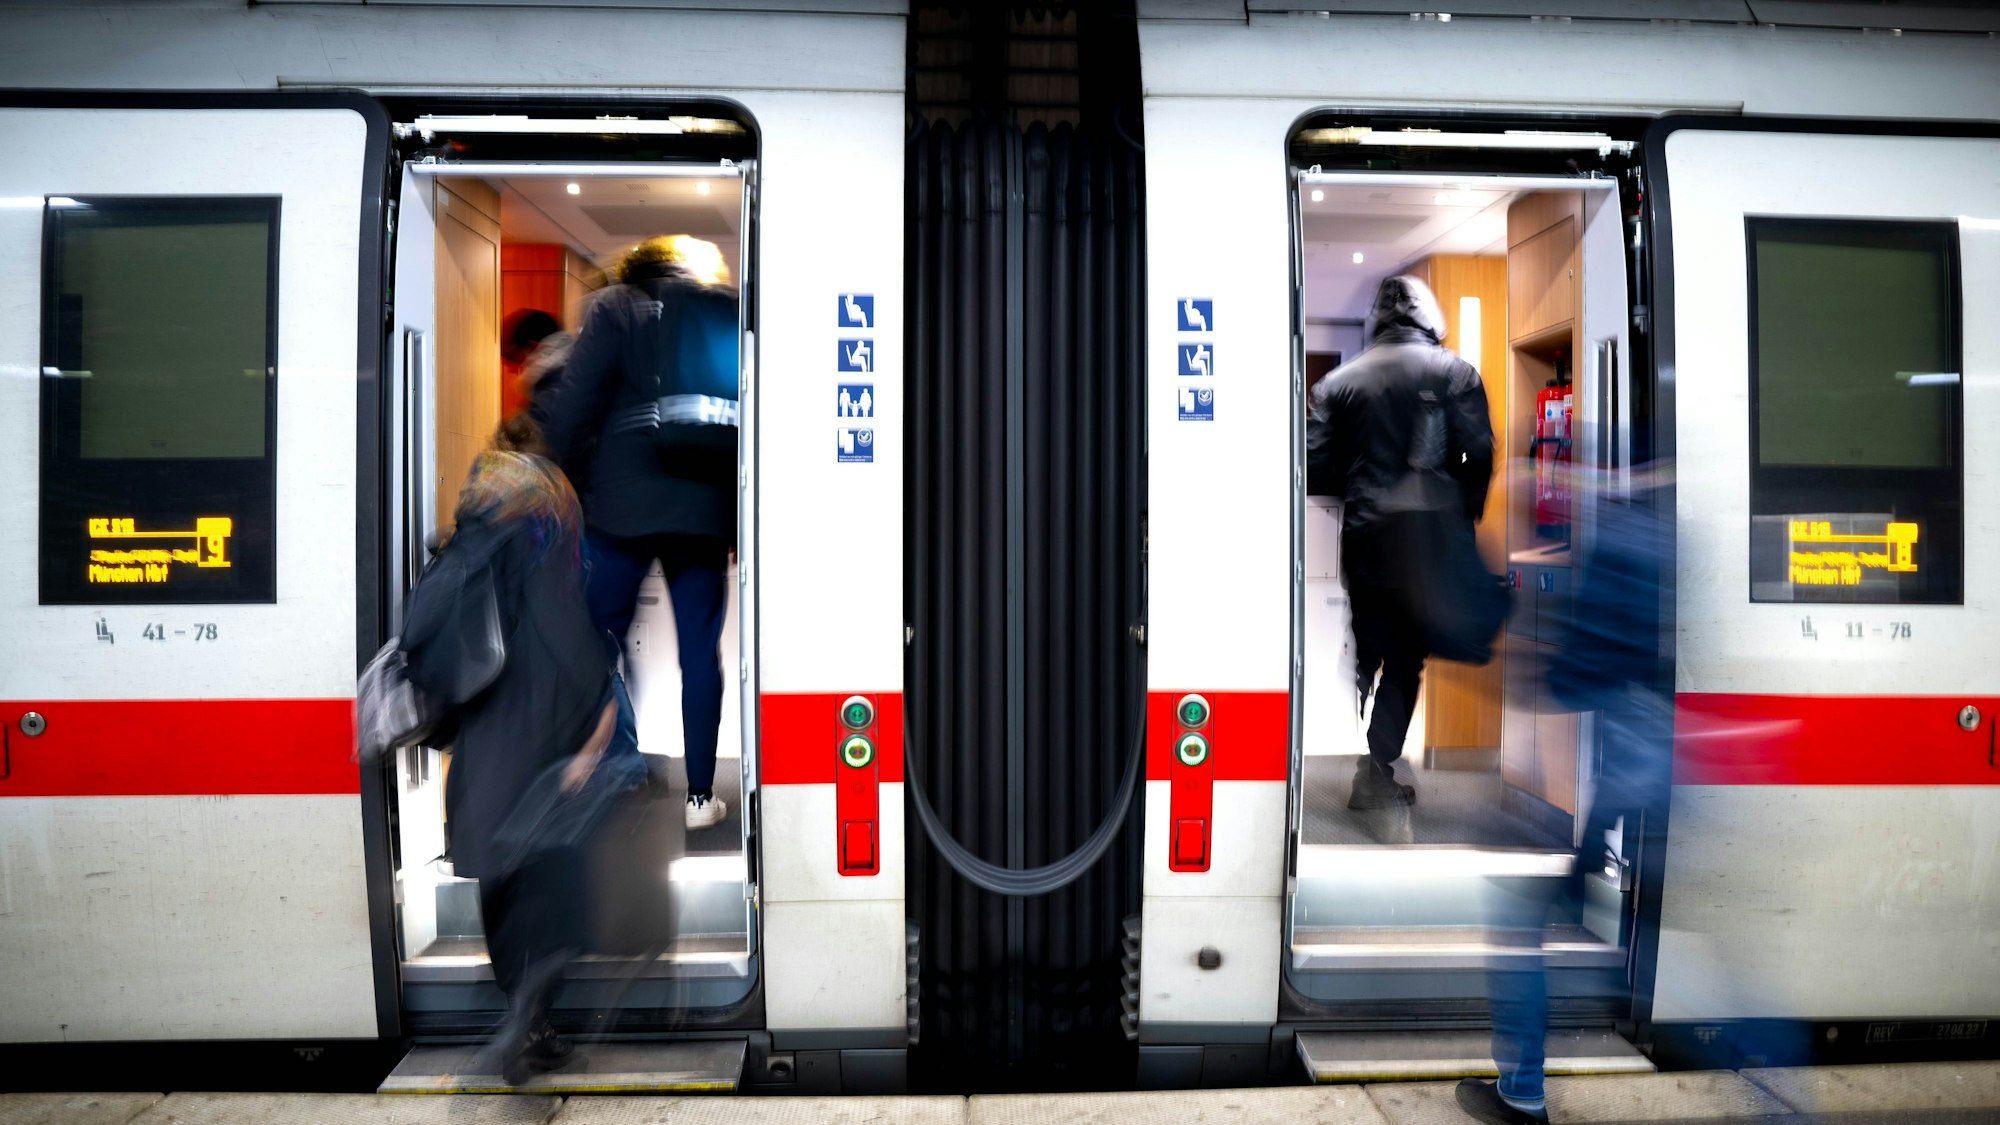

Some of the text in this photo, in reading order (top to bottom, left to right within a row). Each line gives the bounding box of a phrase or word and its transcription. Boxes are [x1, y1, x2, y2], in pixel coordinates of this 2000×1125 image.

[142, 622, 166, 641] 41
[194, 622, 218, 641] 78
[1845, 622, 1864, 638] 11
[1890, 621, 1912, 639] 78
[1873, 1025, 1896, 1039] REV
